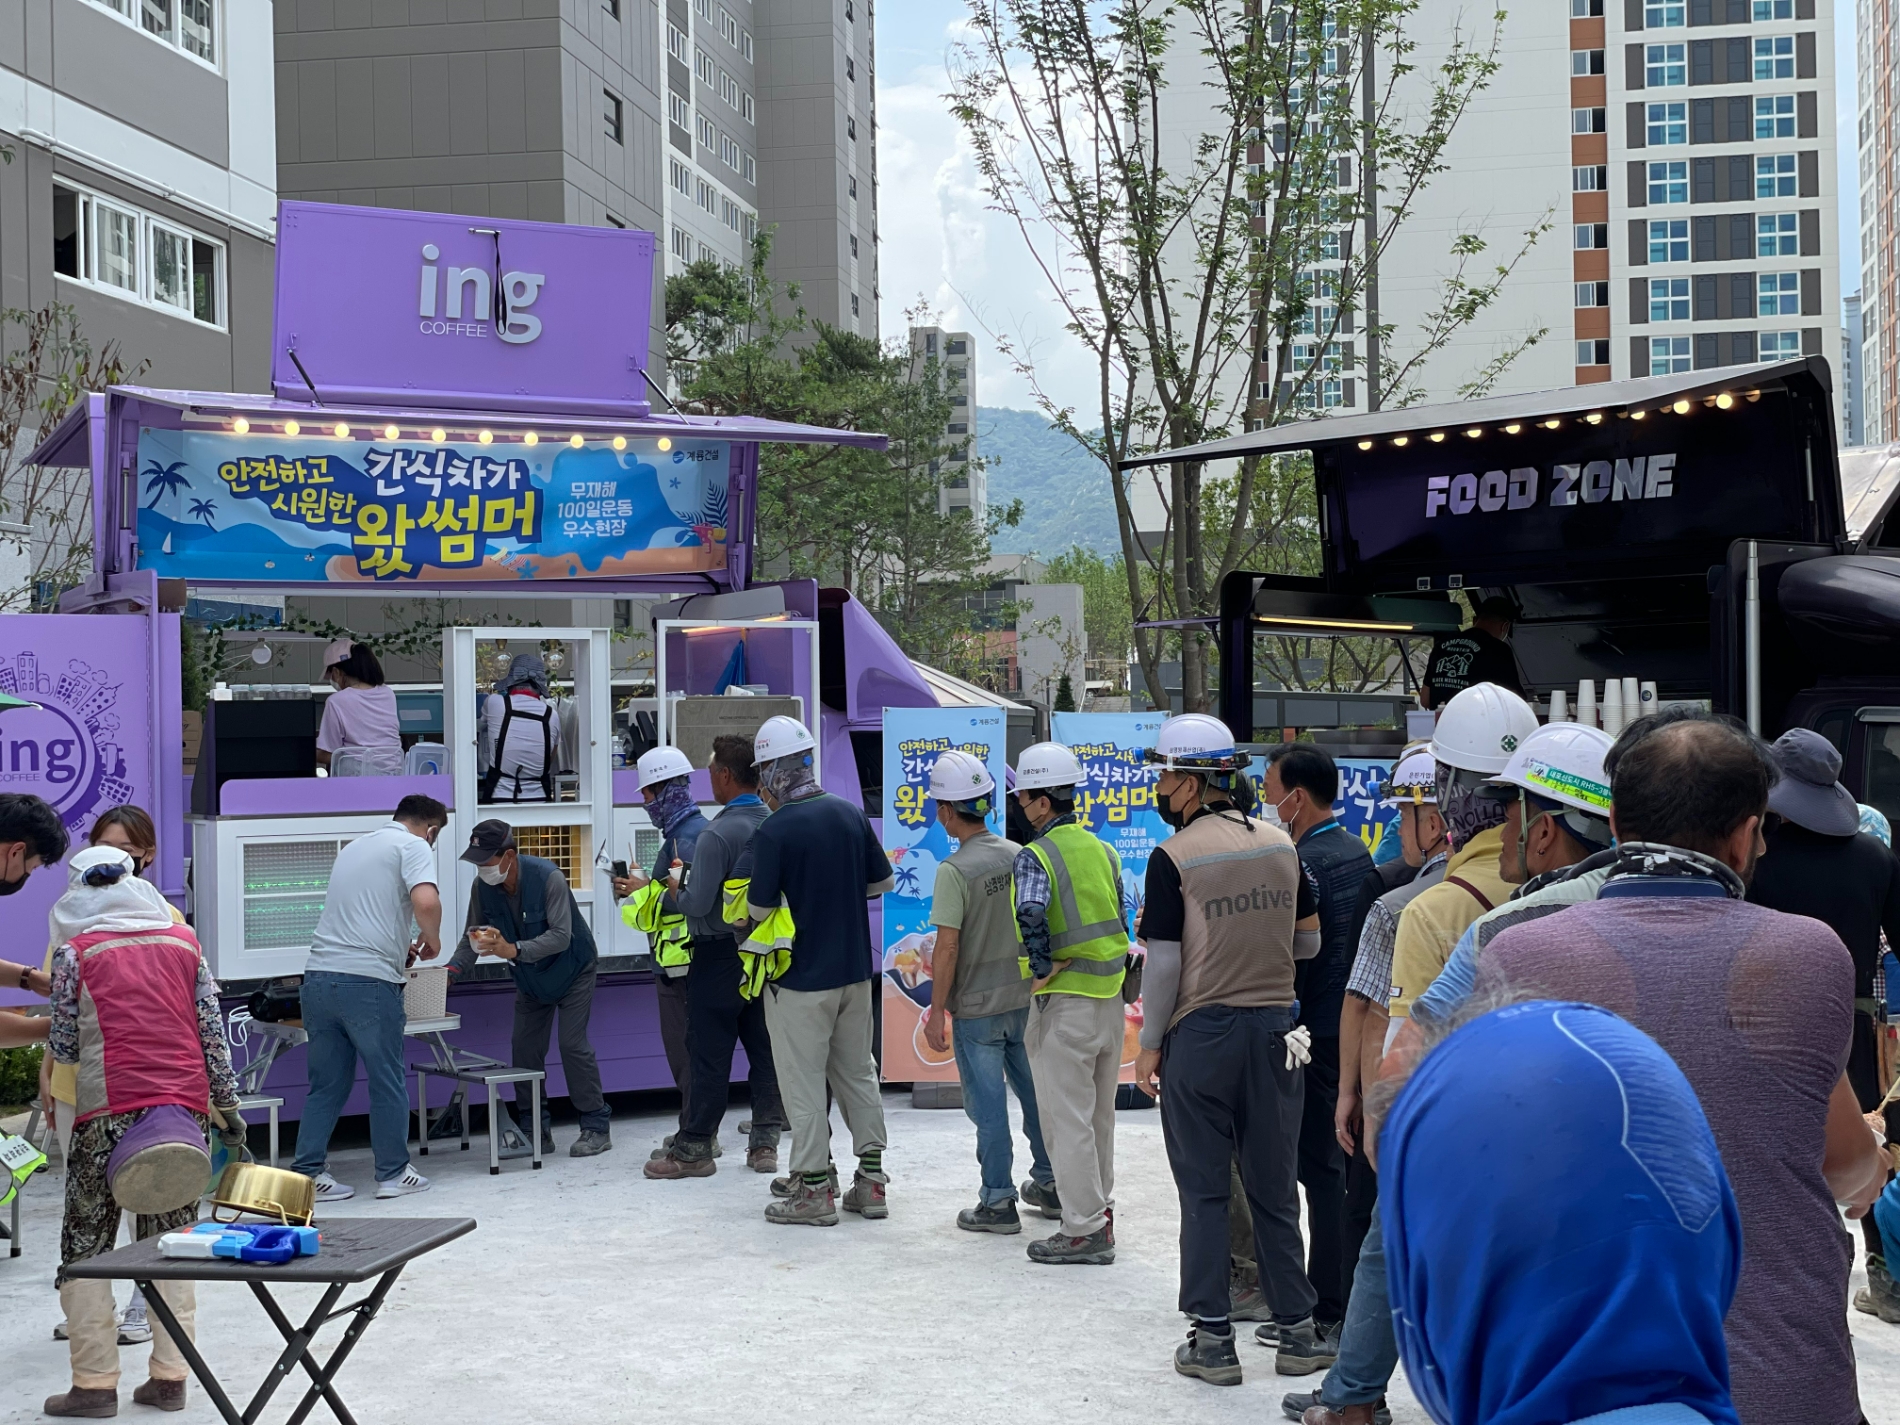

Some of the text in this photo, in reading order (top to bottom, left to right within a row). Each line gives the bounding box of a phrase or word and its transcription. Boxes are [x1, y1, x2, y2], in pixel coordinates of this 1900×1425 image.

[420, 244, 545, 344] ing
[419, 321, 488, 338] COFFEE
[686, 449, 719, 462] 계룡건설
[220, 457, 334, 493] 안전하고
[366, 450, 521, 498] 간식차가
[570, 480, 617, 499] 무재해
[1425, 453, 1677, 518] FOOD ZONE
[271, 487, 357, 525] 시원한
[557, 499, 634, 519] 100일운동
[563, 519, 628, 538] 우수현장
[1441, 638, 1481, 653] CAMPGROUND
[899, 738, 951, 757] 안전하고
[1120, 827, 1147, 837] 무재해
[1204, 884, 1294, 920] motive
